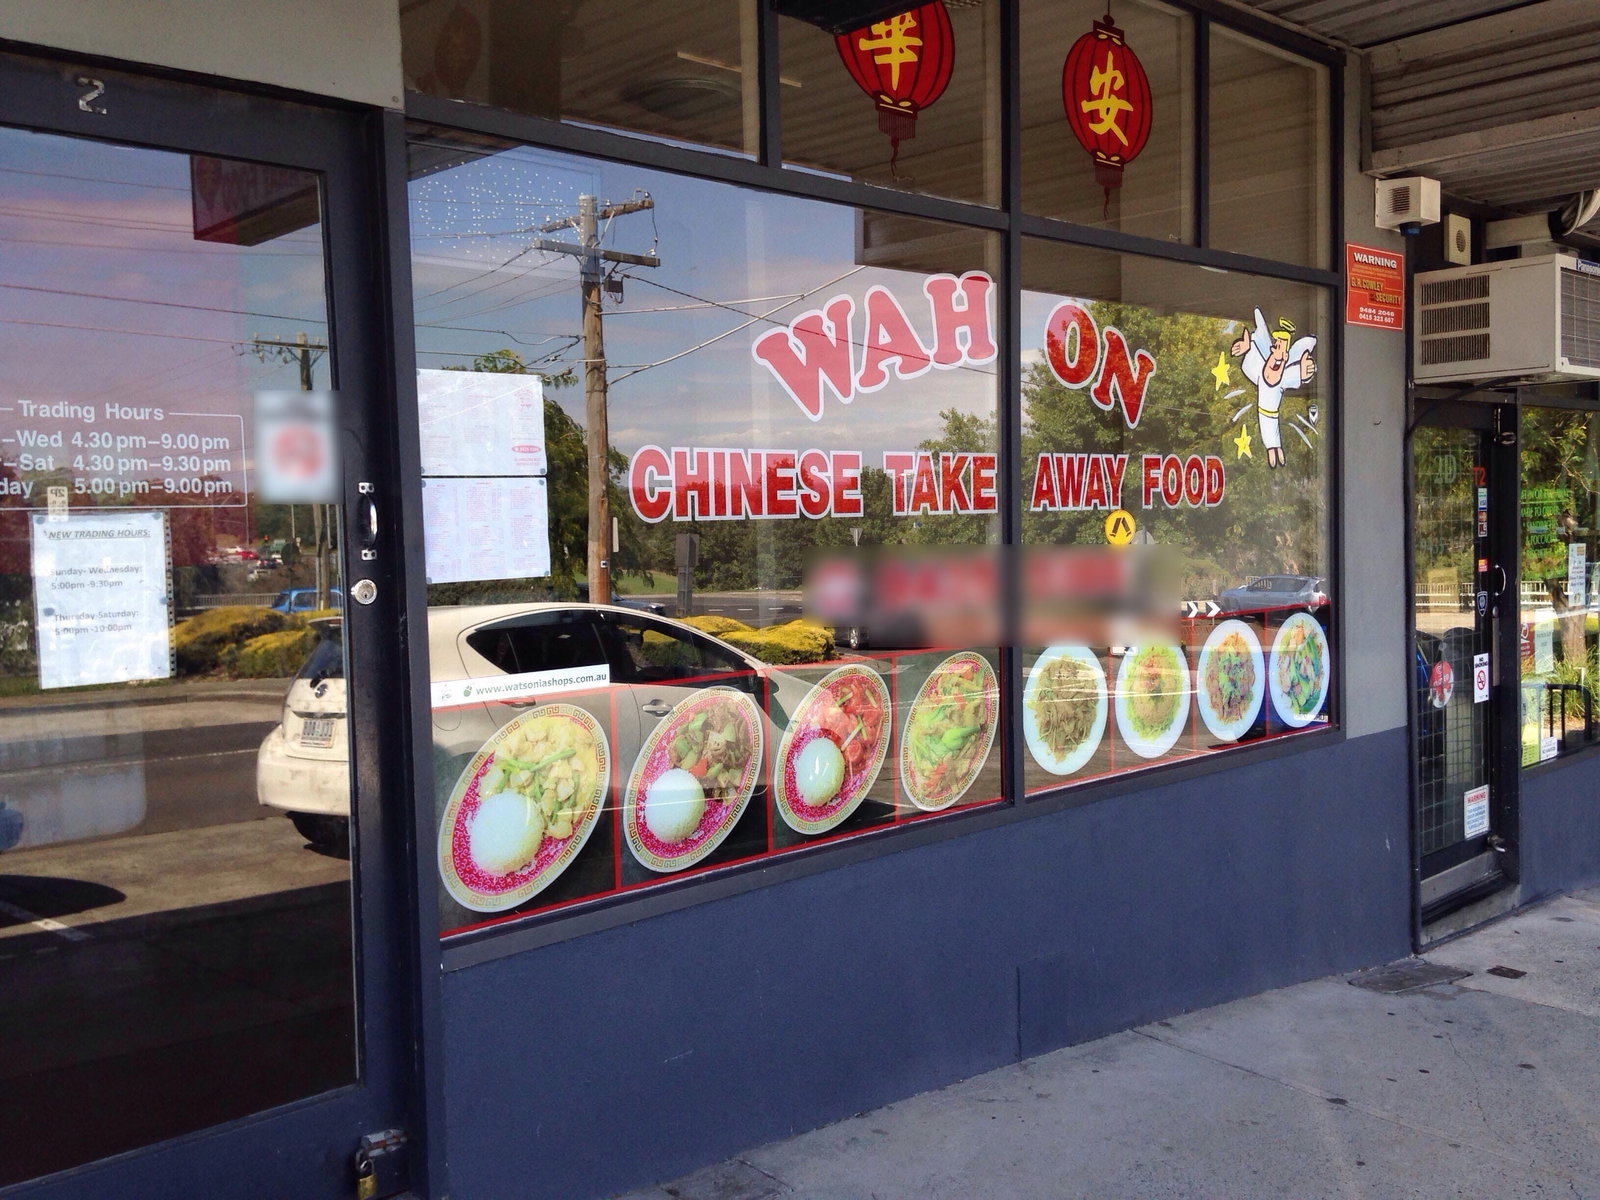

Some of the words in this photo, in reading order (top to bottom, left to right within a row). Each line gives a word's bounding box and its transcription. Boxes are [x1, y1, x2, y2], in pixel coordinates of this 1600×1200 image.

[78, 77, 107, 114] 2
[1080, 50, 1134, 147] 安
[1353, 252, 1397, 269] WARNING
[1375, 292, 1402, 305] SECURITY
[751, 270, 998, 422] WAH
[1044, 300, 1157, 430] ON
[18, 400, 96, 422] Trading
[105, 402, 165, 421] Hours
[628, 444, 865, 524] CHINESE
[883, 450, 999, 516] TAKE
[1030, 453, 1129, 512] AWAY
[1141, 454, 1226, 510] FOOD
[49, 530, 71, 539] NEW
[74, 530, 115, 538] TRADING
[117, 529, 151, 538] HOURS:
[475, 673, 607, 696] www.watsoniashops.com.au
